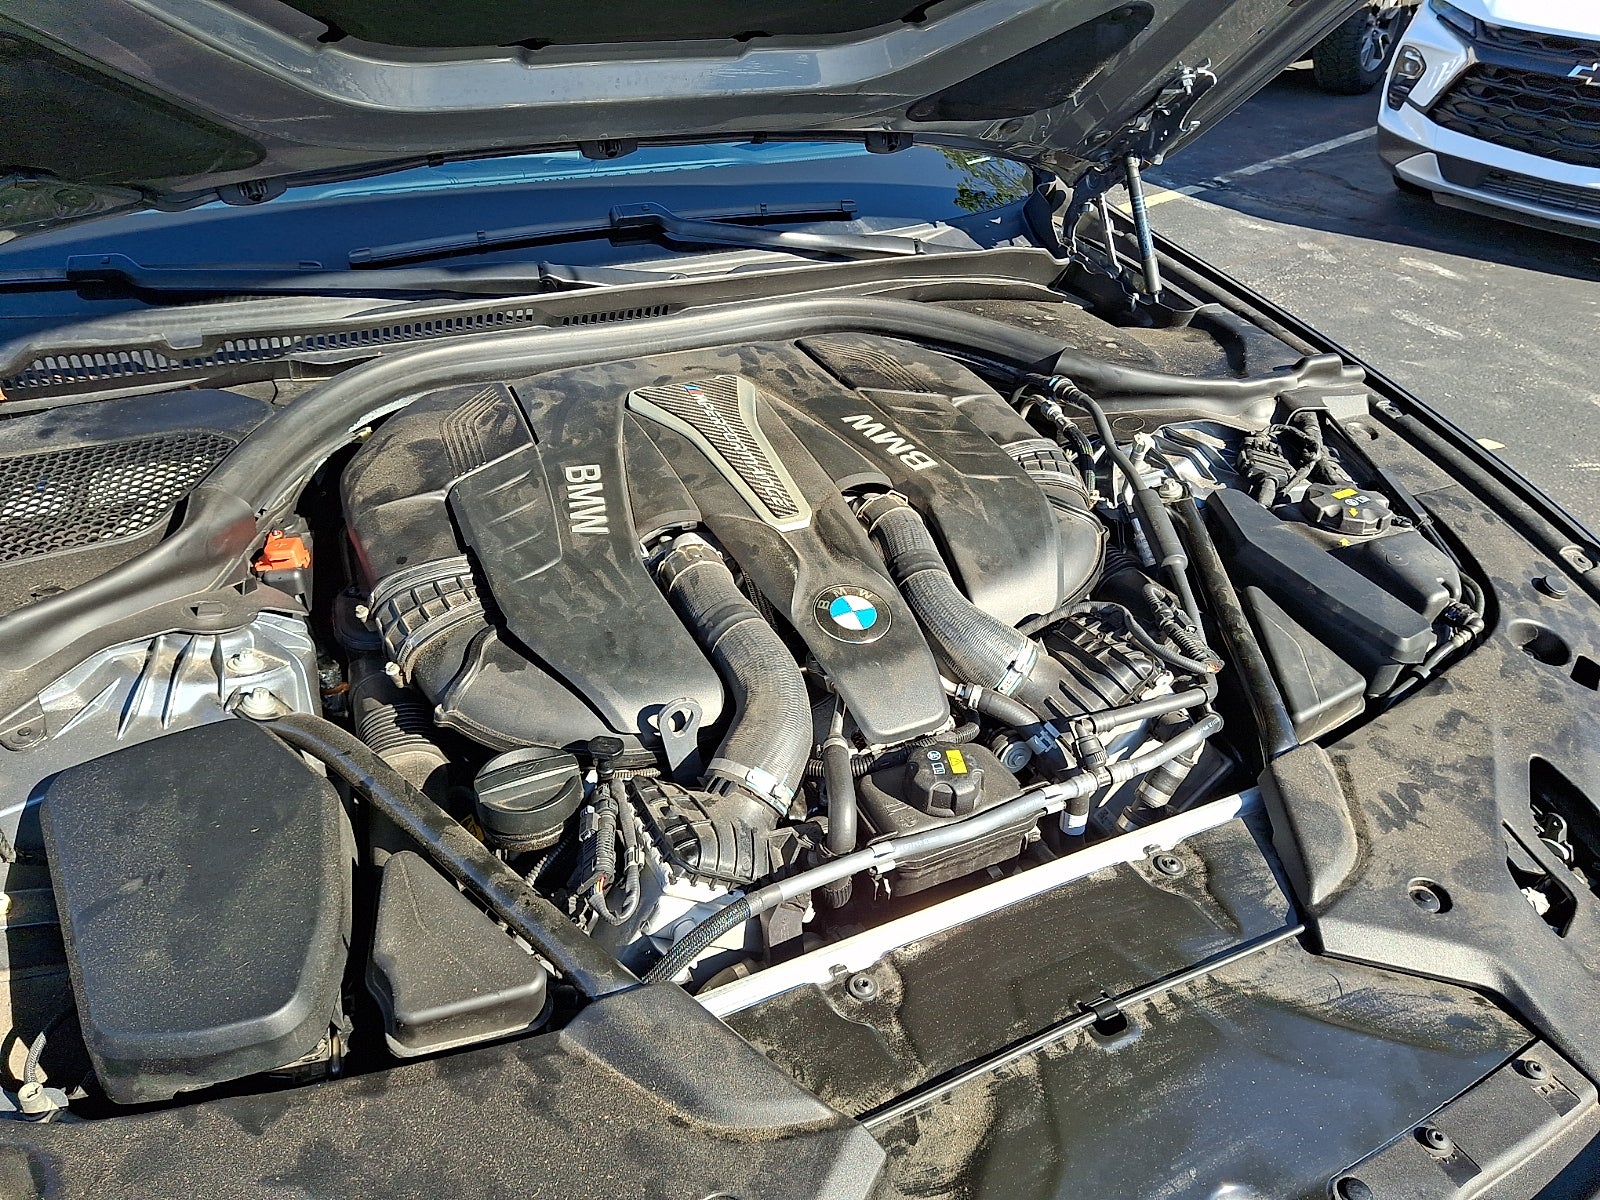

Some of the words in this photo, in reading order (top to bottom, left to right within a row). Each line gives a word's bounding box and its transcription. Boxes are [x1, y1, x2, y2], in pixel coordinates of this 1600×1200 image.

[840, 414, 938, 471] BMW
[565, 464, 610, 534] BMW
[817, 587, 873, 610] BMW
